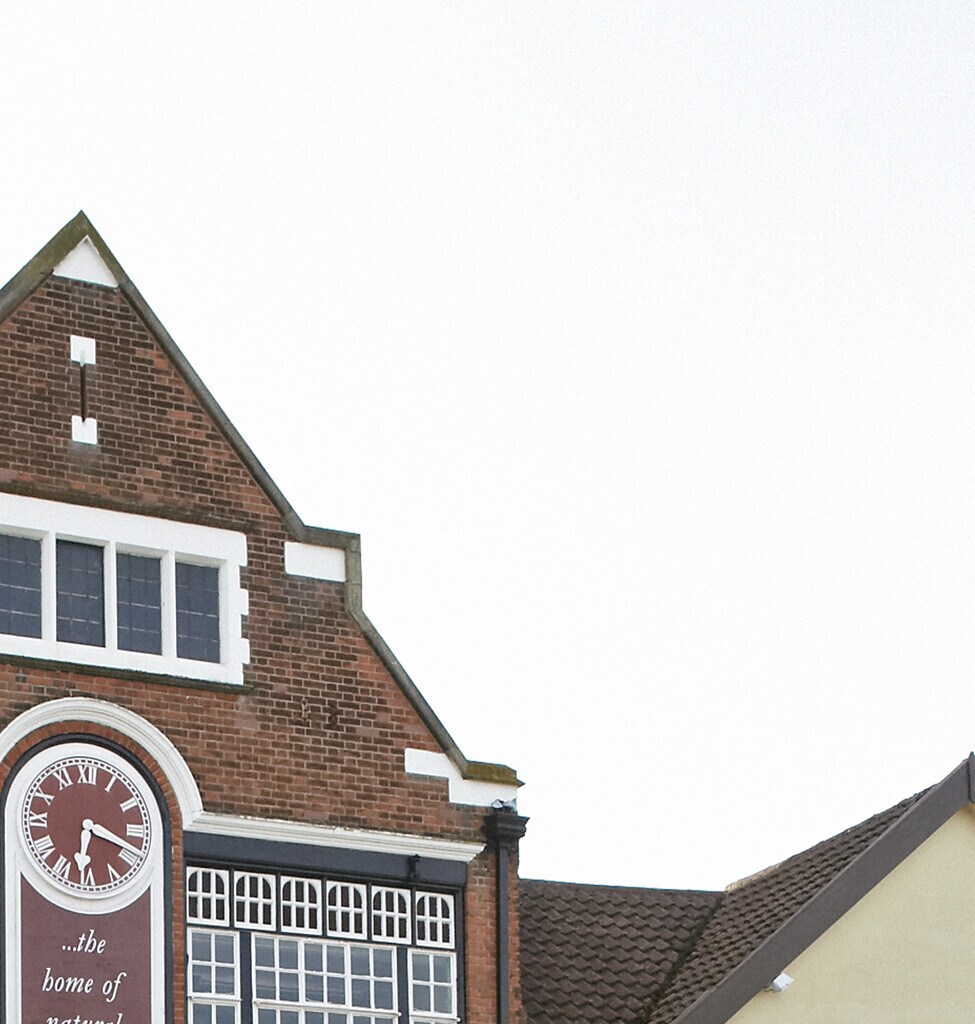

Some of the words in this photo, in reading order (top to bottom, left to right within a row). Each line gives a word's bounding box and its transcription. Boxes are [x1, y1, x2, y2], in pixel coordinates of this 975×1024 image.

[77, 765, 98, 785] XII
[42, 968, 93, 993] home
[102, 972, 127, 1002] of
